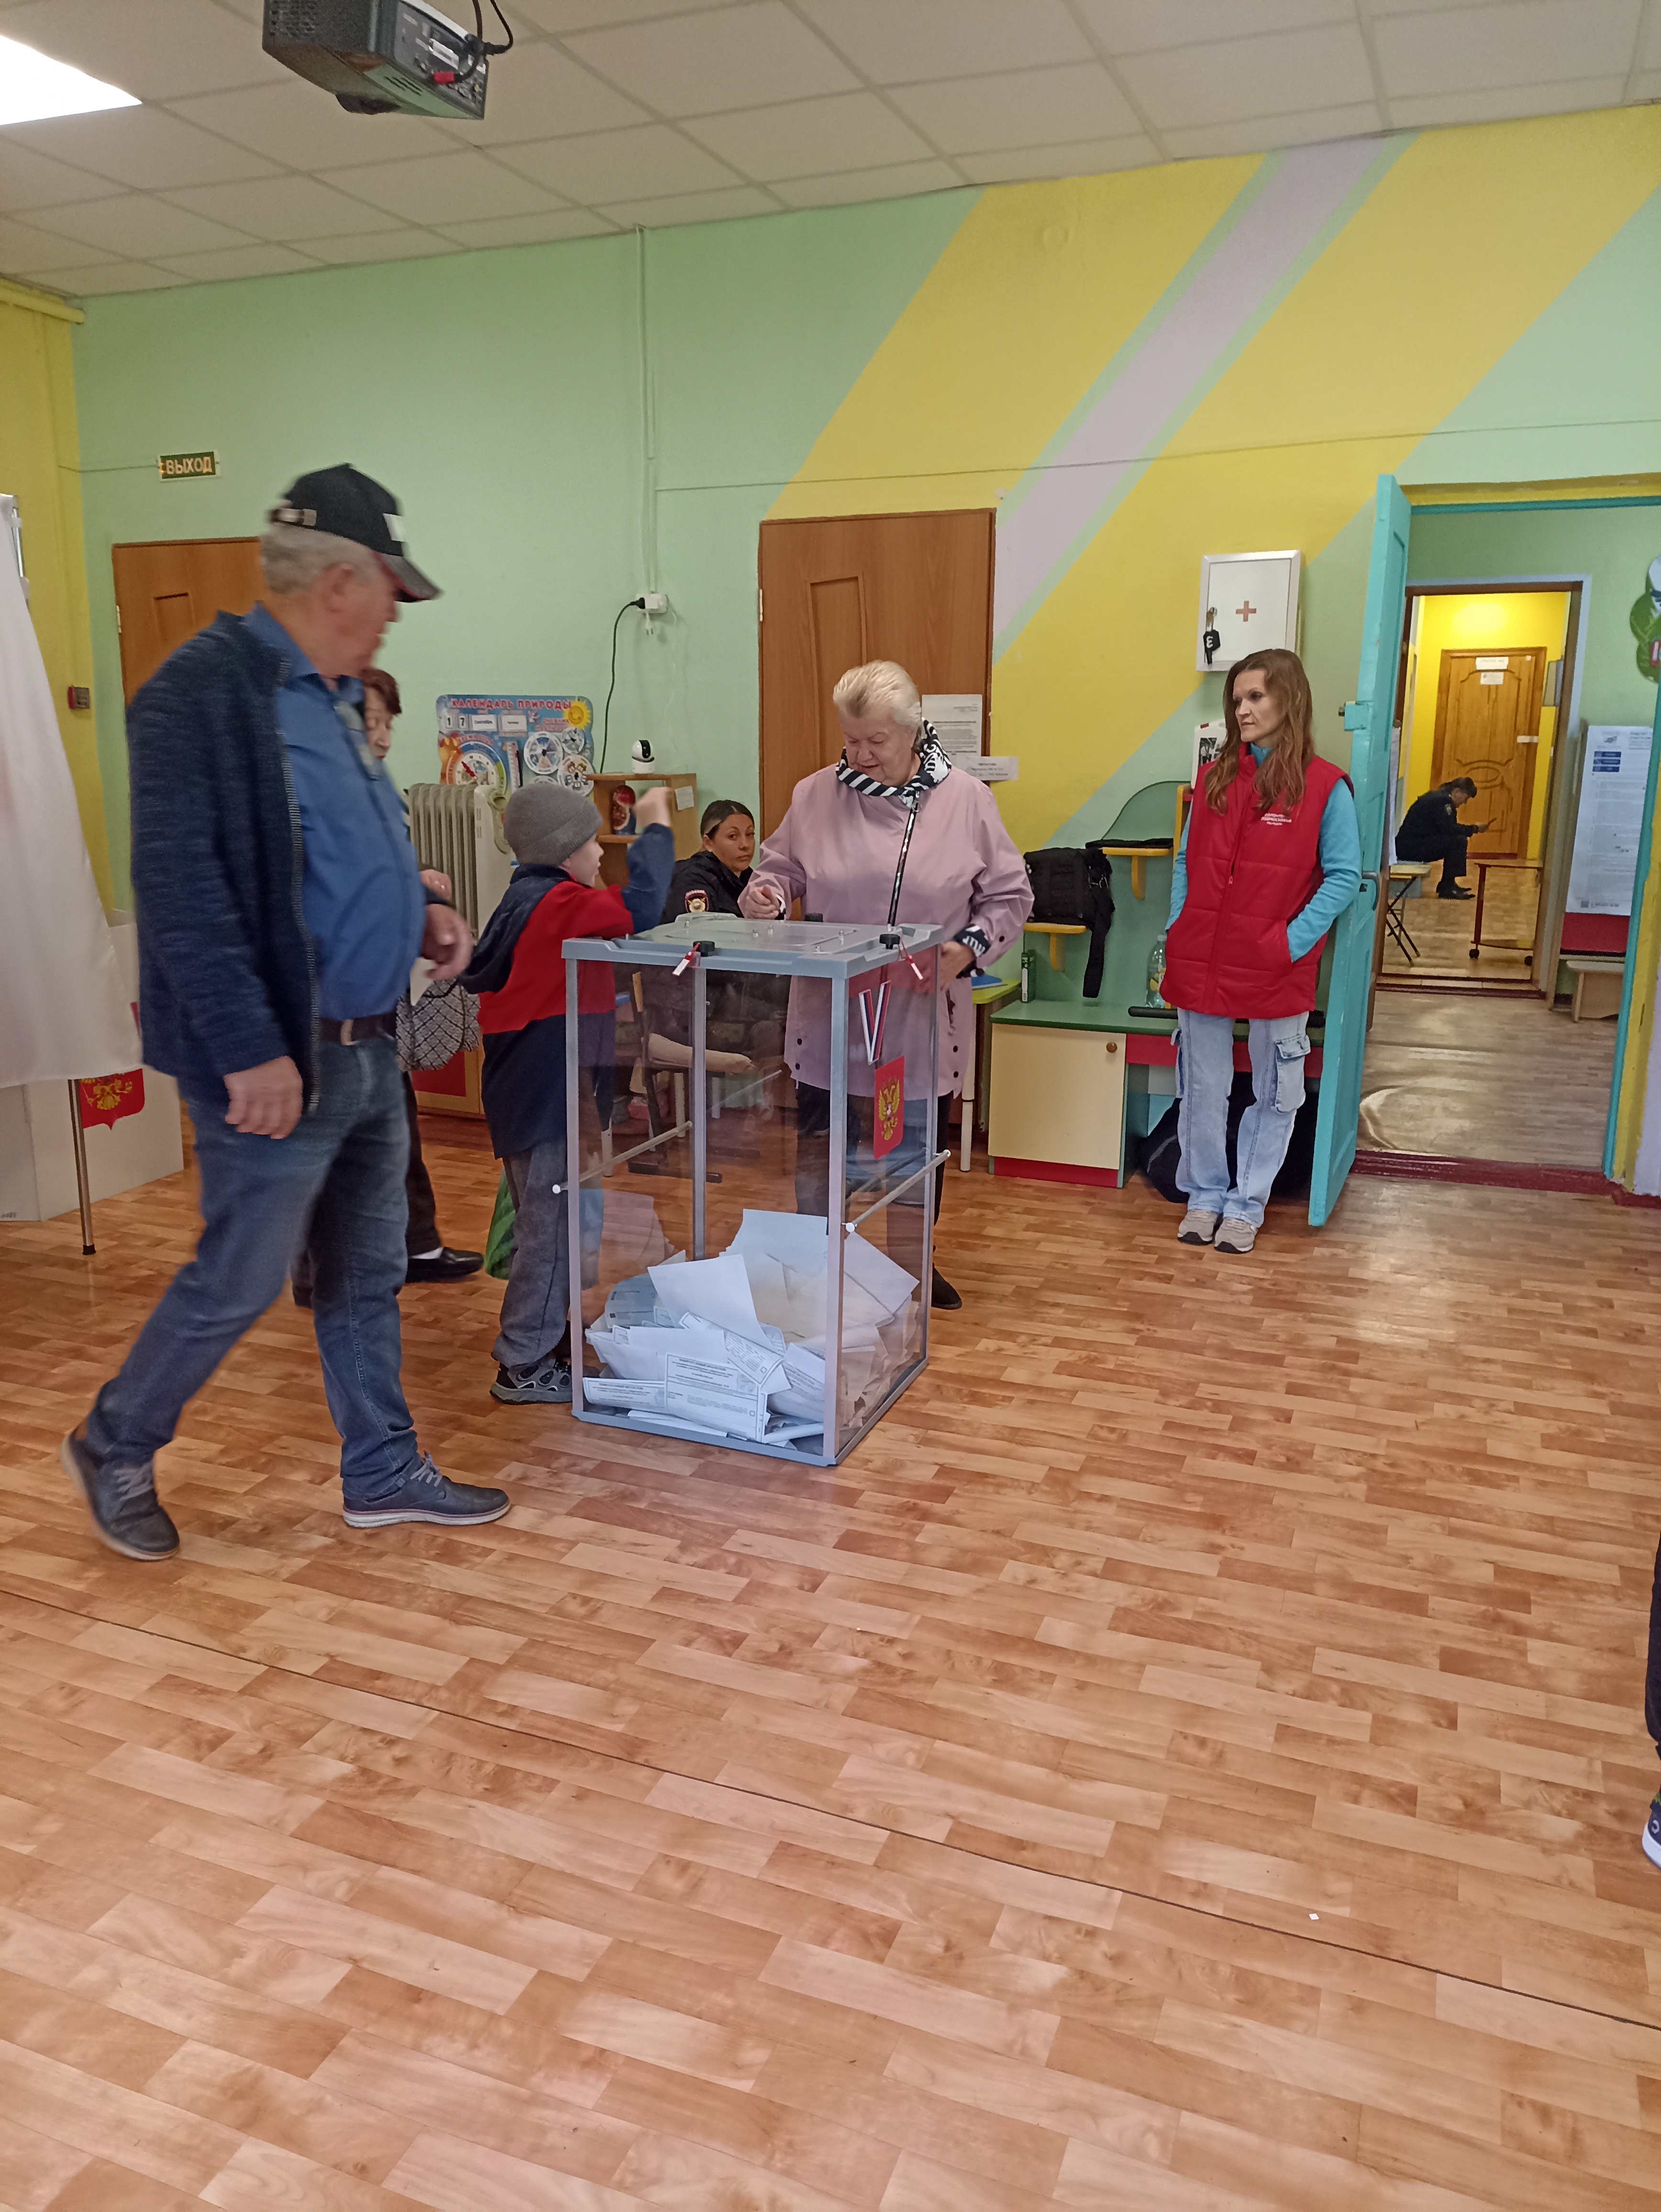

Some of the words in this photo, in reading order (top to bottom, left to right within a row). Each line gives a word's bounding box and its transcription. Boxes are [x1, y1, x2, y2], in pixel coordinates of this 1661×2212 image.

[166, 456, 212, 474] ВЫХОД
[451, 698, 514, 709] КАЛЕНДАРЬ
[517, 699, 571, 710] ПРИРОДЫ
